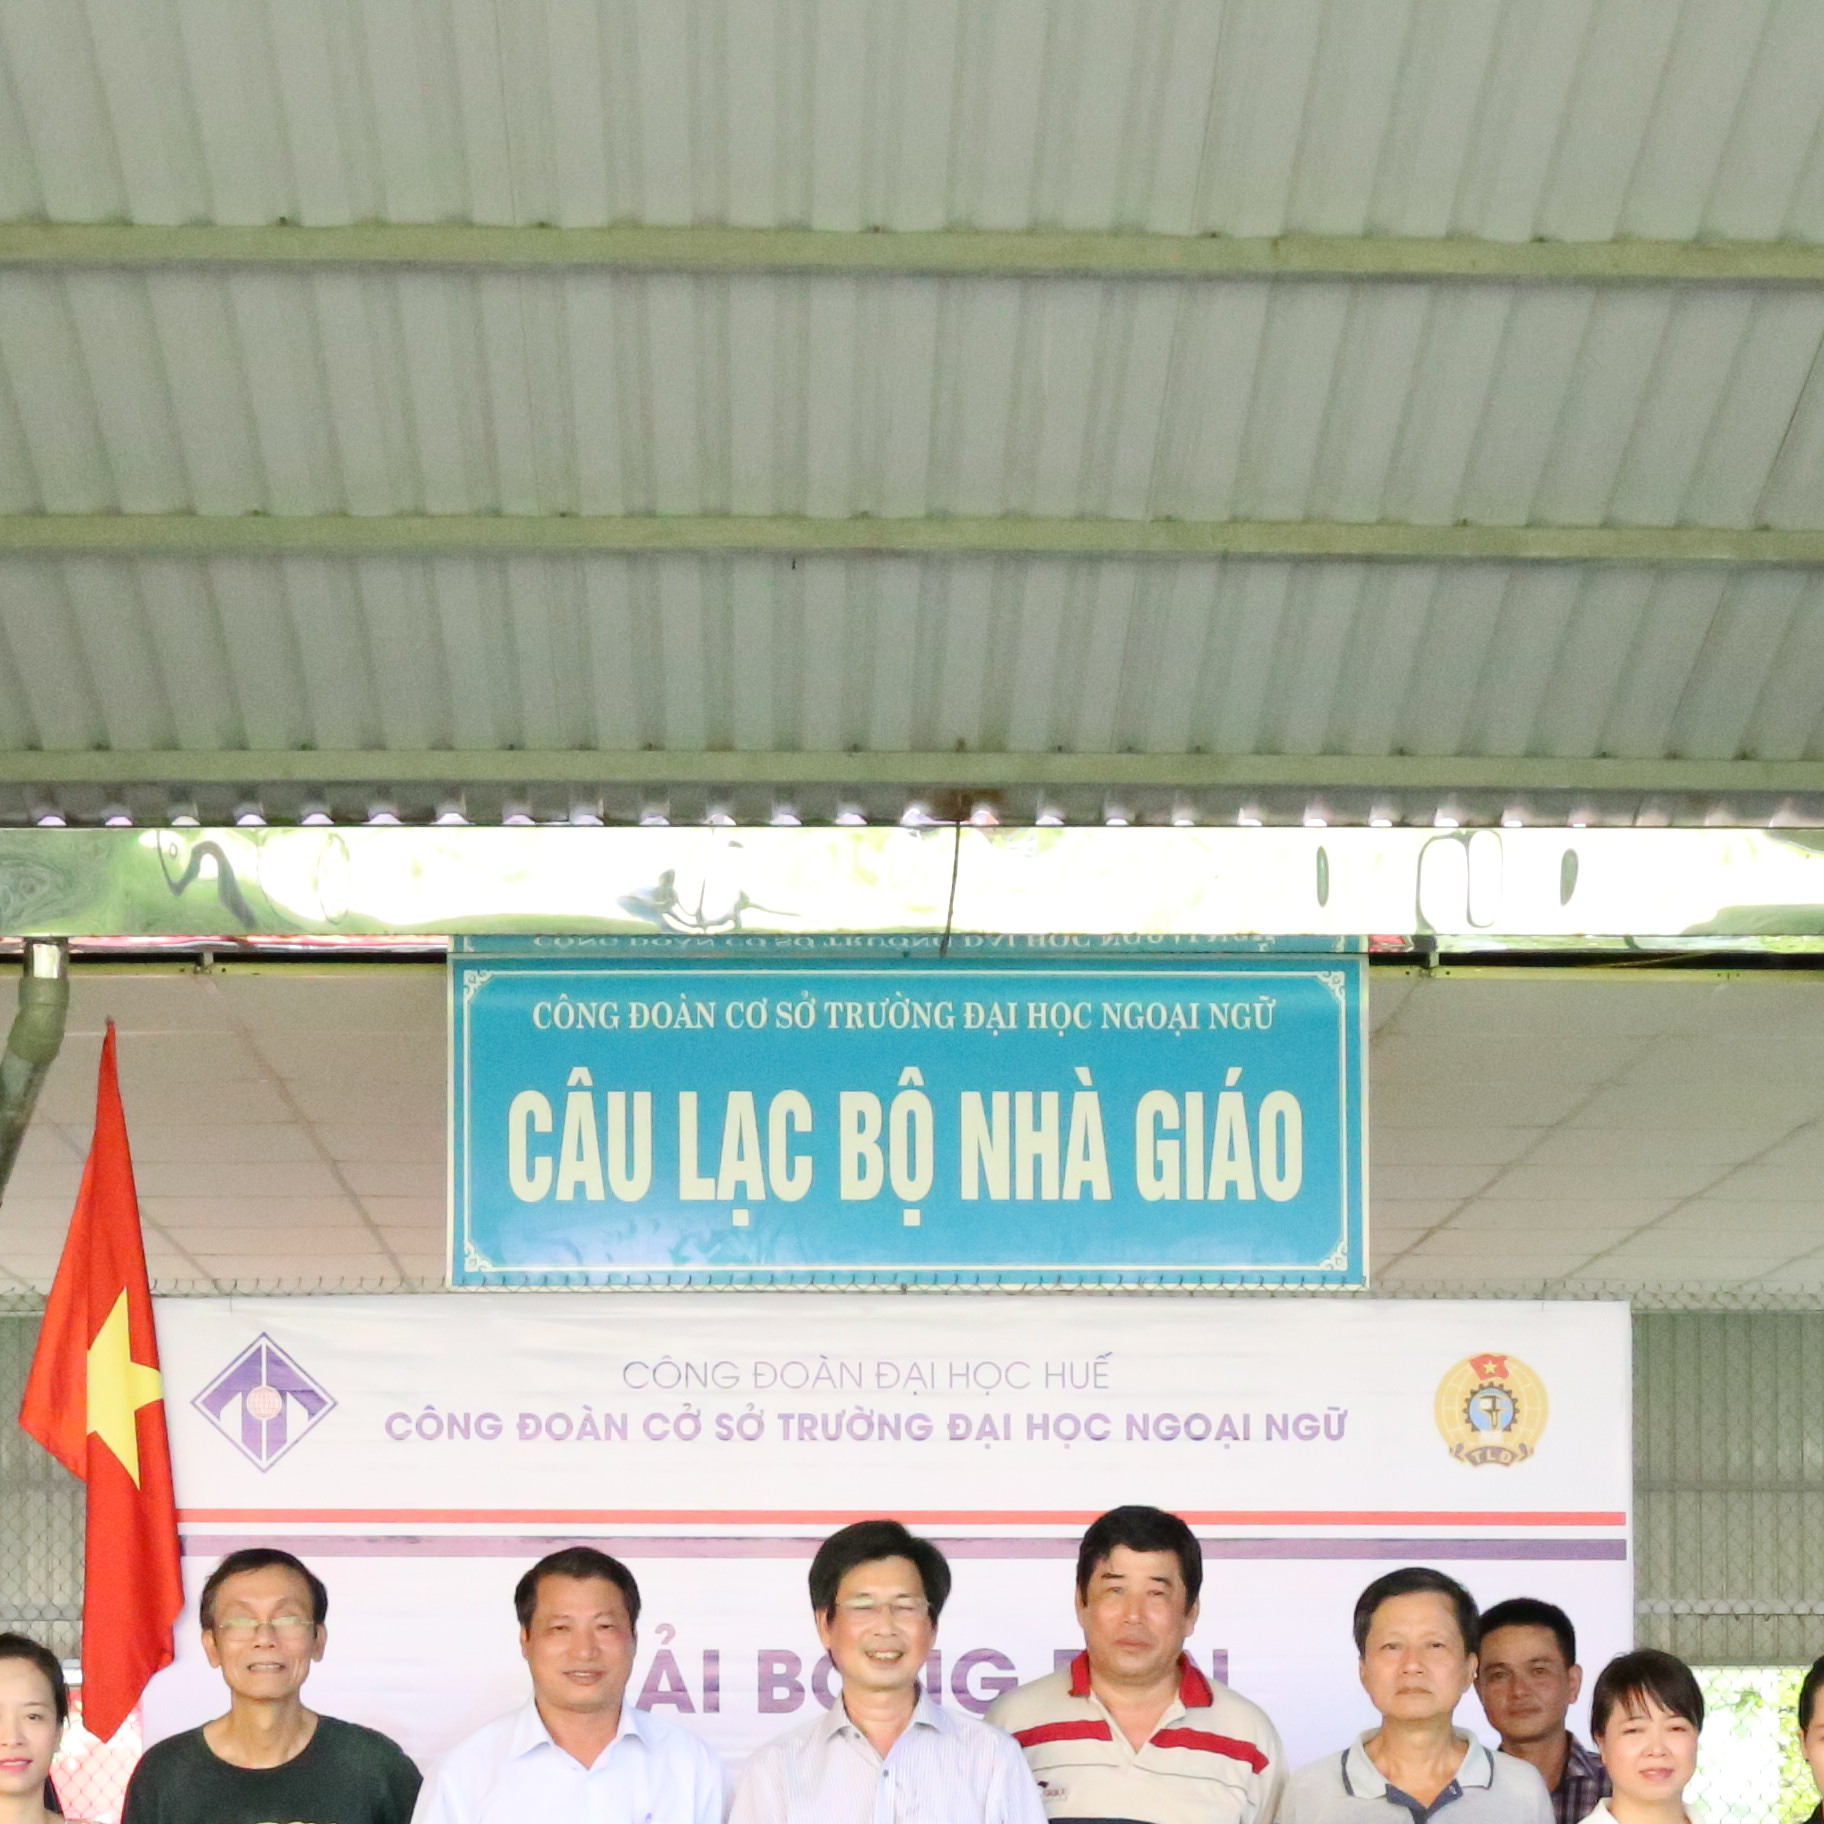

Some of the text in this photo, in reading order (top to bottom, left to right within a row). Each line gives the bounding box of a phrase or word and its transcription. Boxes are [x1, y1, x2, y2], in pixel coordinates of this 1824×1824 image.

[532, 990, 1277, 1038] CÔNG ĐOÀN CƠ SỞ TRƯỜNG ĐẠI HỌC NGOẠI NGỮ
[508, 1066, 1304, 1227] CÂU LẠC BỘ NHÀ GIÁO
[622, 1351, 1113, 1396] CÔNG ĐOÀN ĐẠI HỌC HUẾ
[384, 1404, 503, 1441] CÔNG
[516, 1404, 629, 1441] ĐOÀN
[716, 1402, 765, 1441] SỞ
[778, 1404, 933, 1441] TRƯỜNG
[947, 1412, 1012, 1449] ĐẠI
[1027, 1412, 1111, 1449] HỌC
[1126, 1412, 1251, 1449] NGOẠI
[1266, 1406, 1348, 1441] NGỮ
[635, 1622, 720, 1714] ẢI
